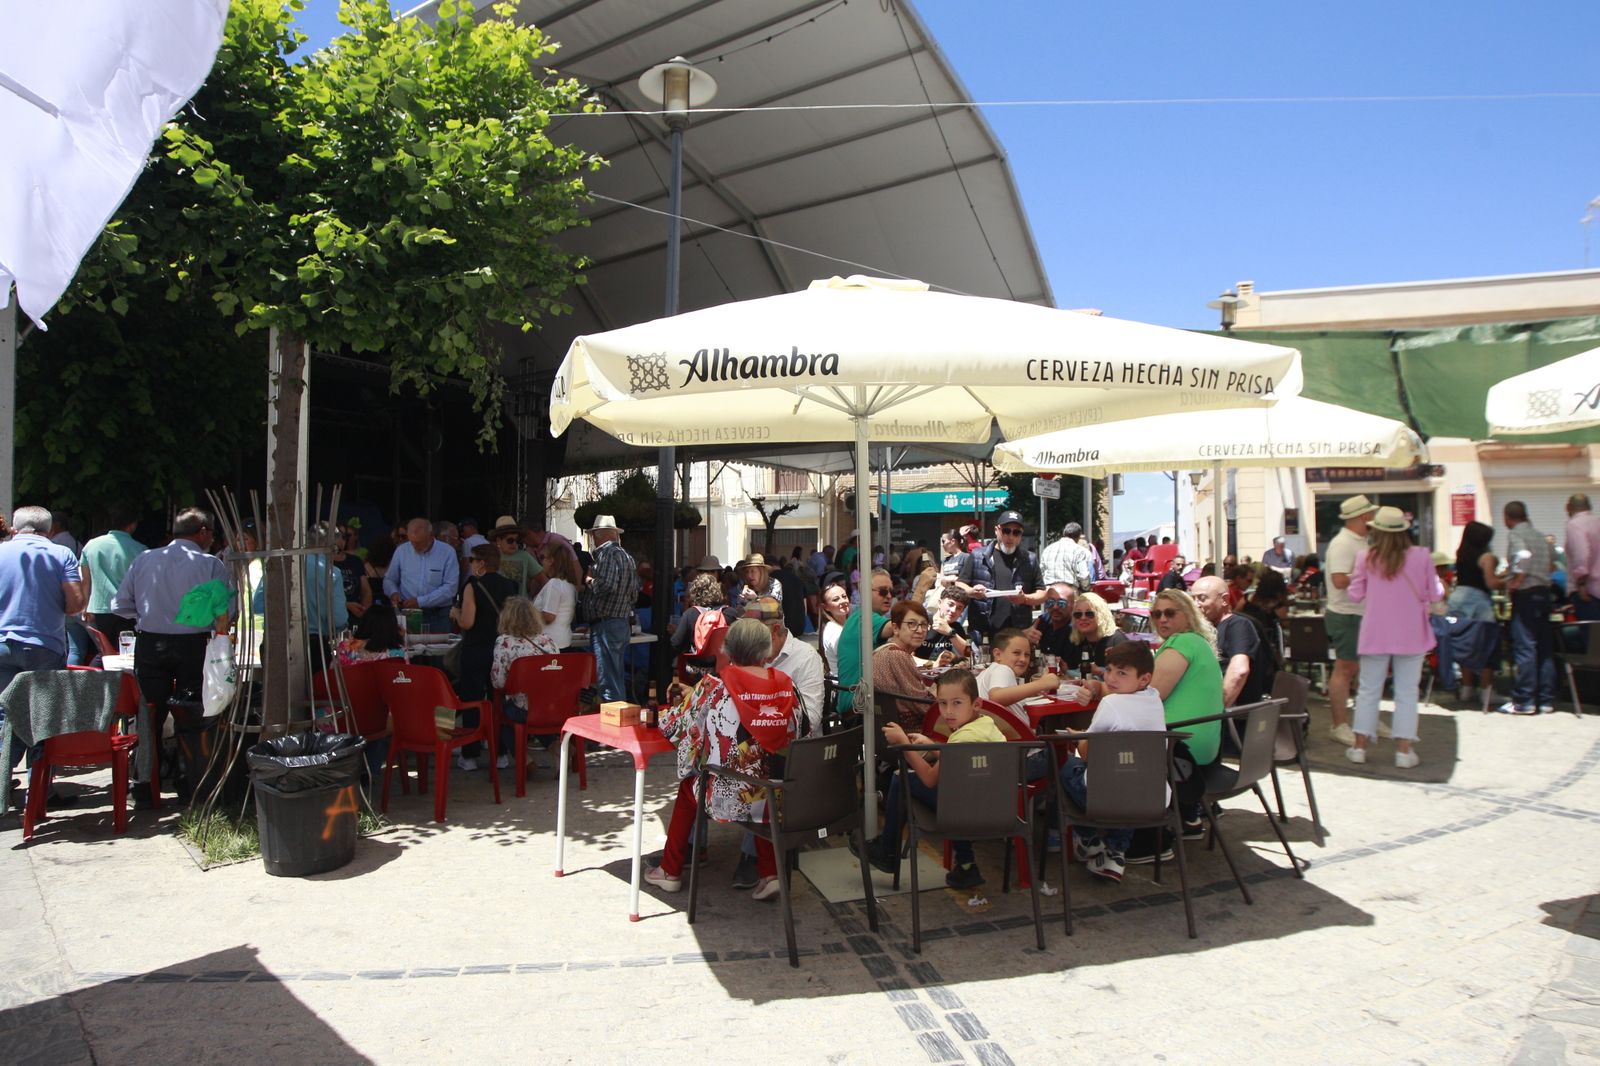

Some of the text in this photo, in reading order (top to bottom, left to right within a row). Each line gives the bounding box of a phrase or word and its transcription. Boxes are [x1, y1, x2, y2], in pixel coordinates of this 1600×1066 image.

[679, 346, 840, 389] Alhambra
[1026, 358, 1275, 395] CERVEZA HECHA SIN PRISA
[1031, 447, 1100, 465] Alhambra
[1198, 441, 1383, 457] CERVEZA HECHA SIN PRISA
